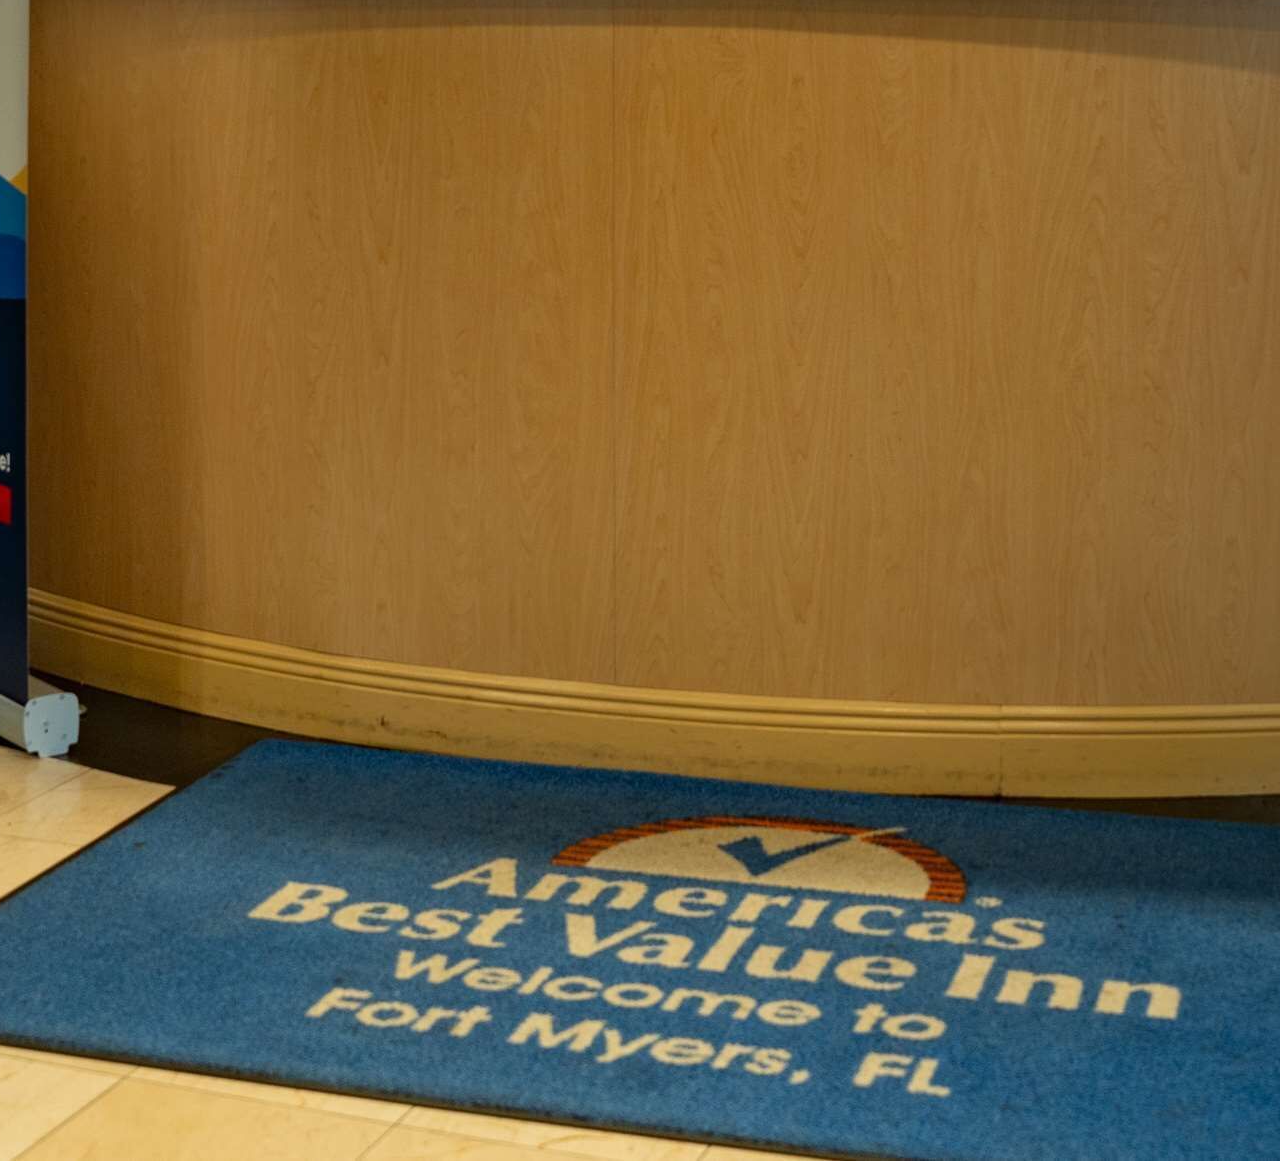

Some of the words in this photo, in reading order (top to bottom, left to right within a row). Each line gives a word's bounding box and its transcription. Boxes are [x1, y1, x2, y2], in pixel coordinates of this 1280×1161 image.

[248, 881, 524, 948] Best
[565, 913, 918, 991] Value
[945, 953, 1181, 1020] Inn
[395, 950, 822, 1026] Welcome
[851, 1002, 947, 1040] to
[305, 987, 492, 1038] Fort
[508, 1013, 811, 1085] Myers,
[851, 1052, 952, 1097] FL
